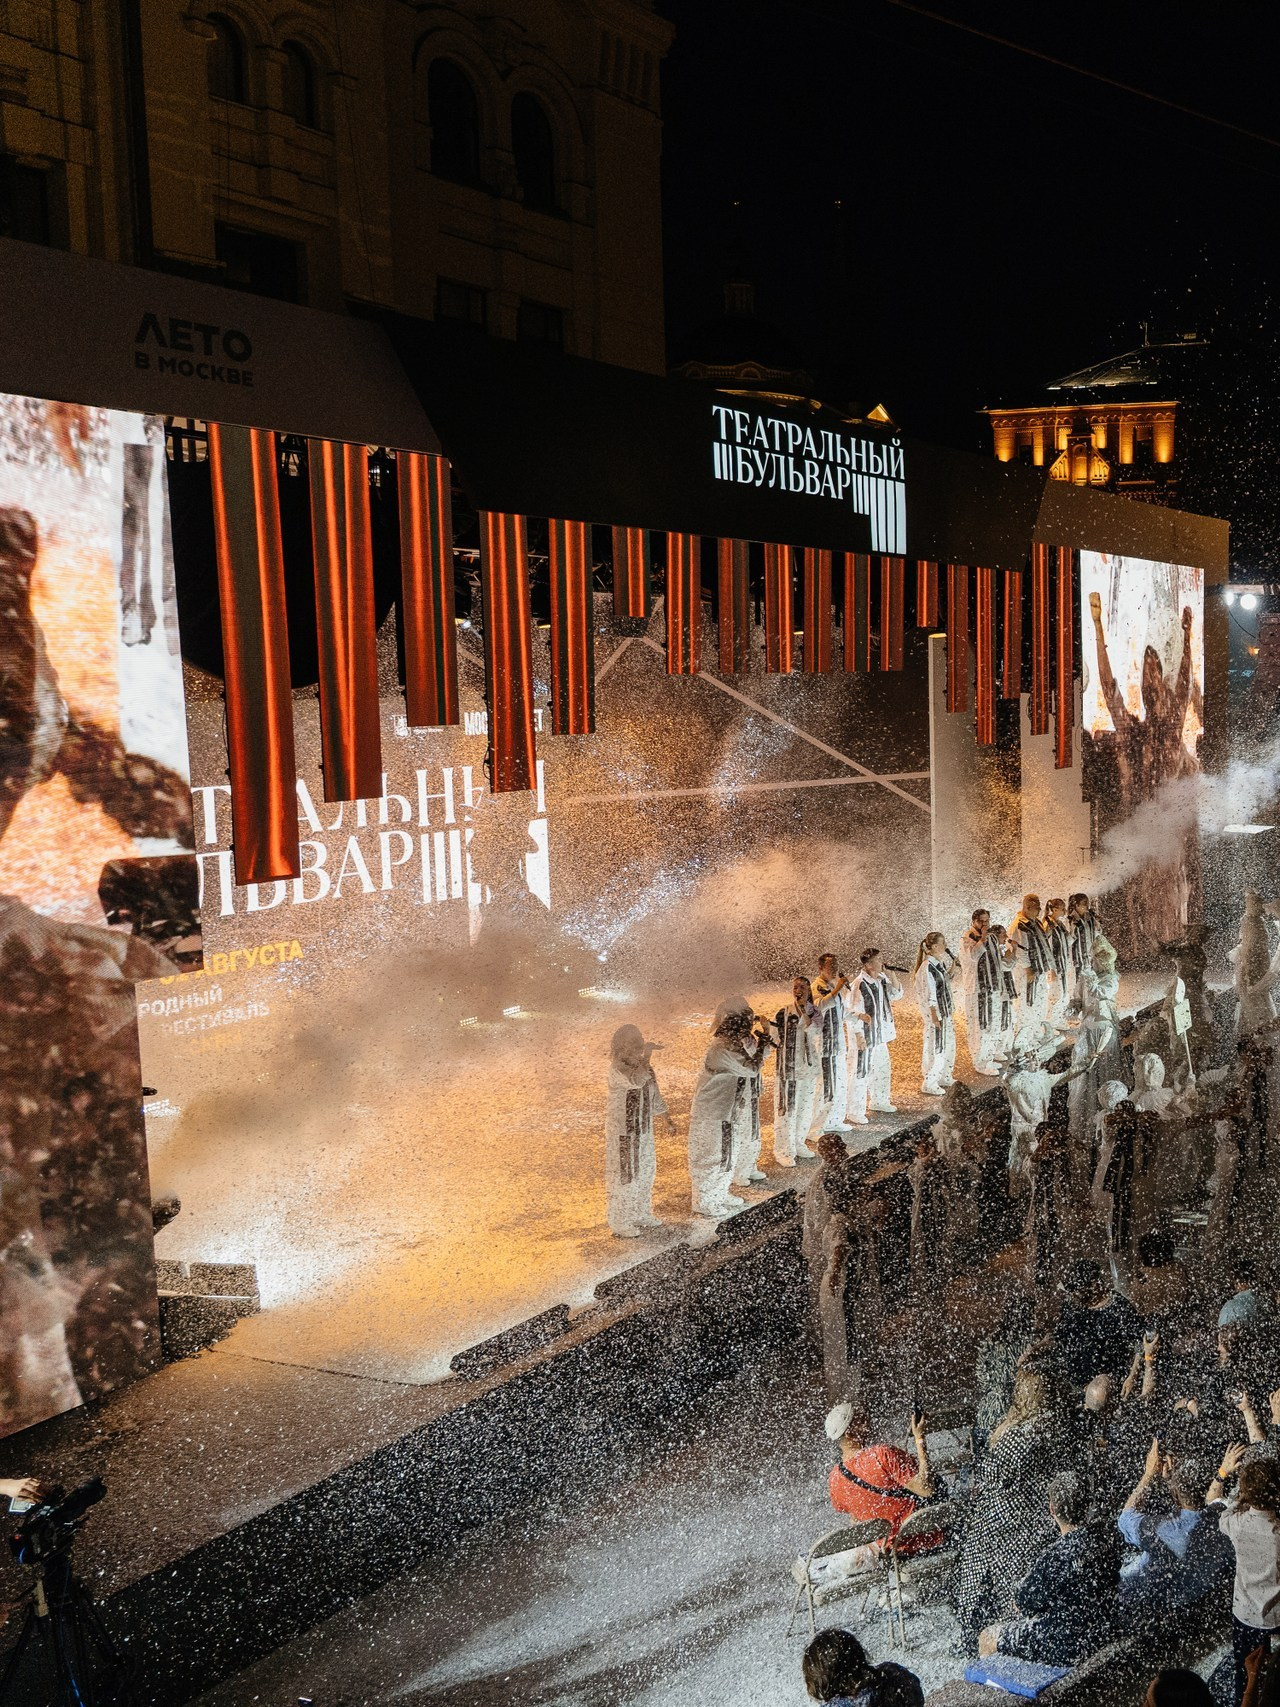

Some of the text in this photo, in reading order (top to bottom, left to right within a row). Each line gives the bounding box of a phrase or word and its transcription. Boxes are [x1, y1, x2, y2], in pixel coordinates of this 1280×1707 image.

[135, 312, 252, 362] ЛЕТО
[135, 351, 254, 387] В МОСКВЕ
[712, 405, 905, 480] ТЕАТРАЛЬНЫЙ
[736, 446, 850, 500] БУЛЬВАР
[160, 1000, 270, 1036] ЕСТИВАЛЬ
